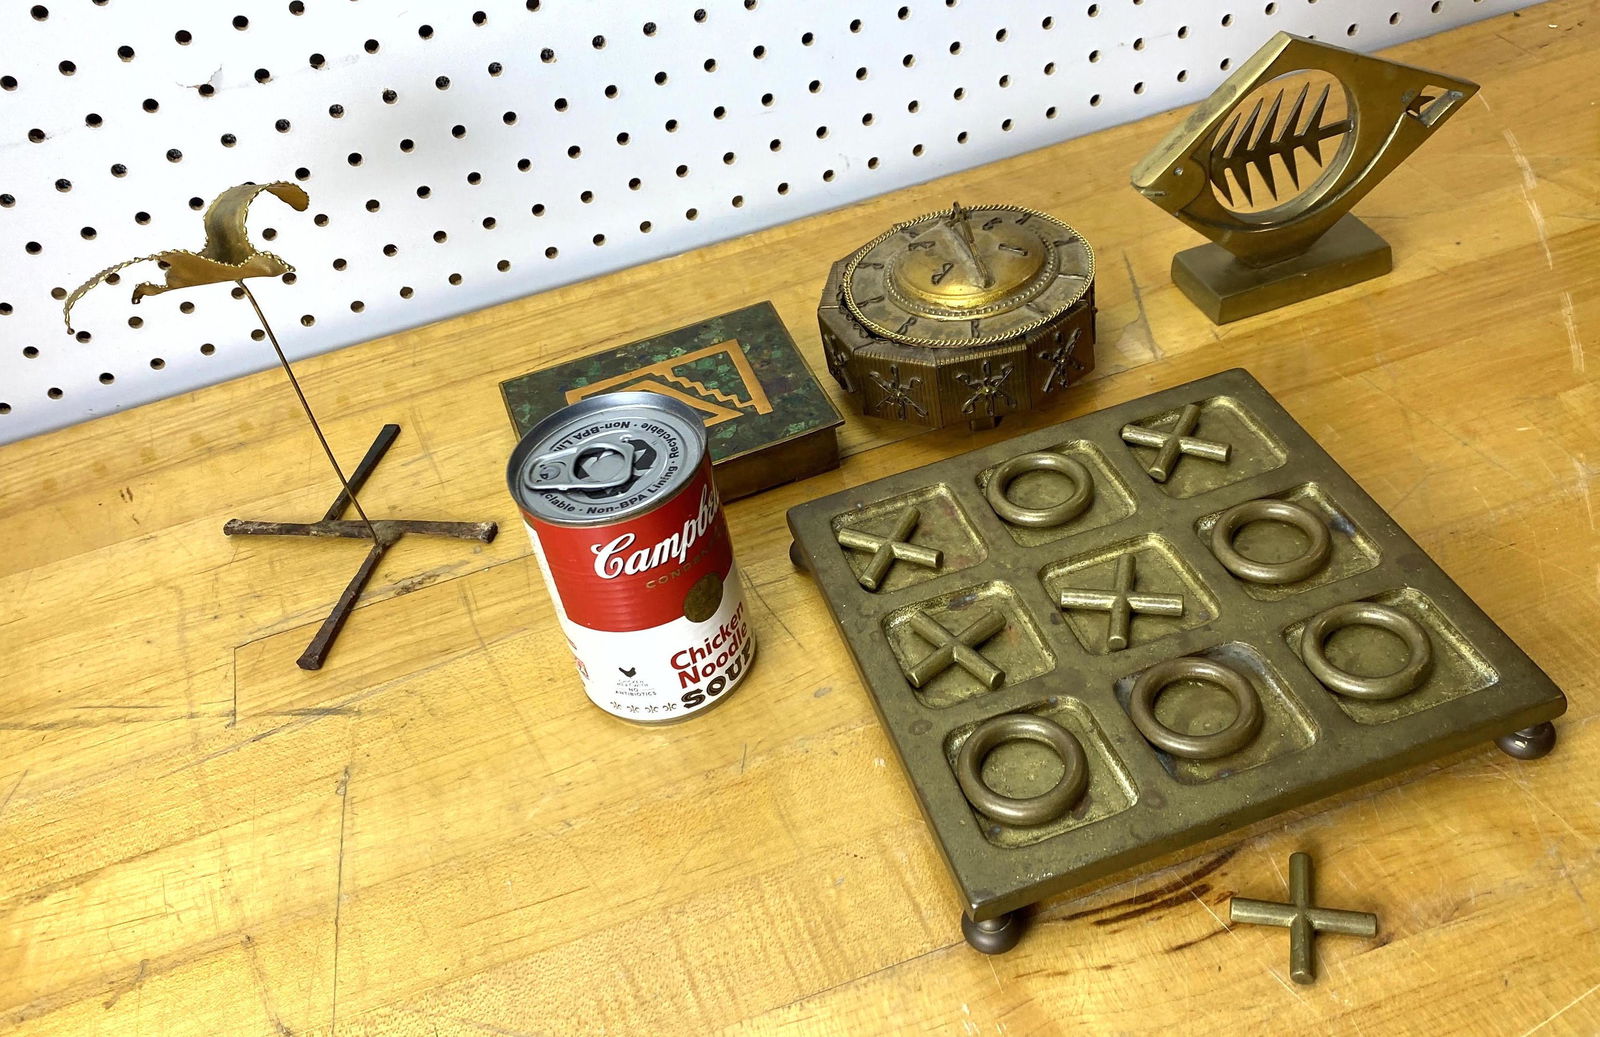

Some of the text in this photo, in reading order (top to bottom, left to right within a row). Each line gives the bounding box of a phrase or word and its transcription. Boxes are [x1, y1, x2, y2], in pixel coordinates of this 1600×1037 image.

[572, 421, 631, 440] Non-BPA
[641, 422, 680, 459] Recyclable
[647, 466, 679, 493] Lining
[586, 495, 648, 514] Non-BPA
[670, 601, 744, 671] Chicken
[678, 622, 748, 690] Noodle
[681, 636, 752, 709] SOUP
